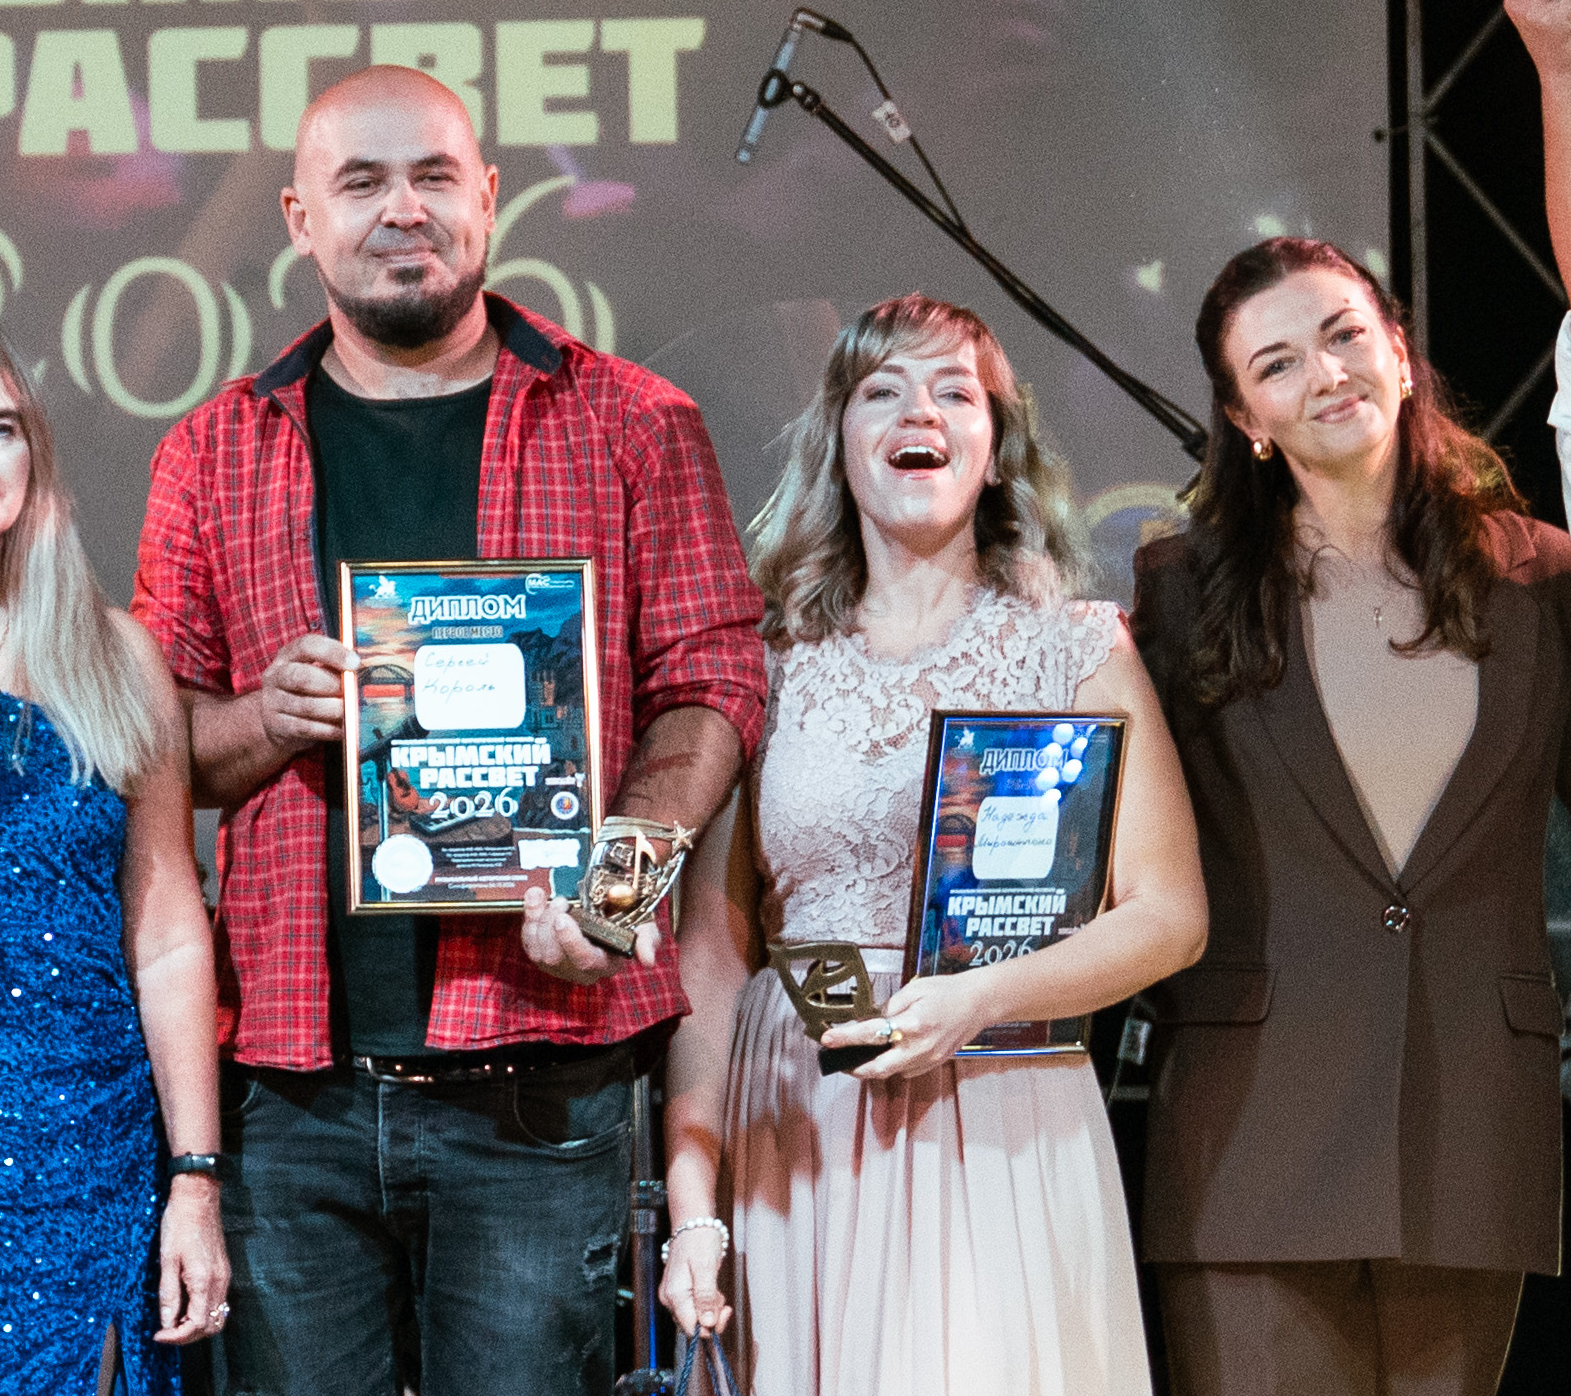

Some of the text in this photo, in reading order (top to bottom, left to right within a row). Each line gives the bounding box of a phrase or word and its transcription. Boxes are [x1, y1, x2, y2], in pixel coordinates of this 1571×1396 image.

[408, 593, 527, 625] ДИПЛОМ
[391, 737, 552, 768] КРЫМСКИЙ
[419, 765, 540, 790] РАССВЕТ
[428, 786, 519, 819] 2026
[947, 889, 1067, 916] КРЫМСКИЙ
[965, 916, 1055, 938] РАССВЕТ
